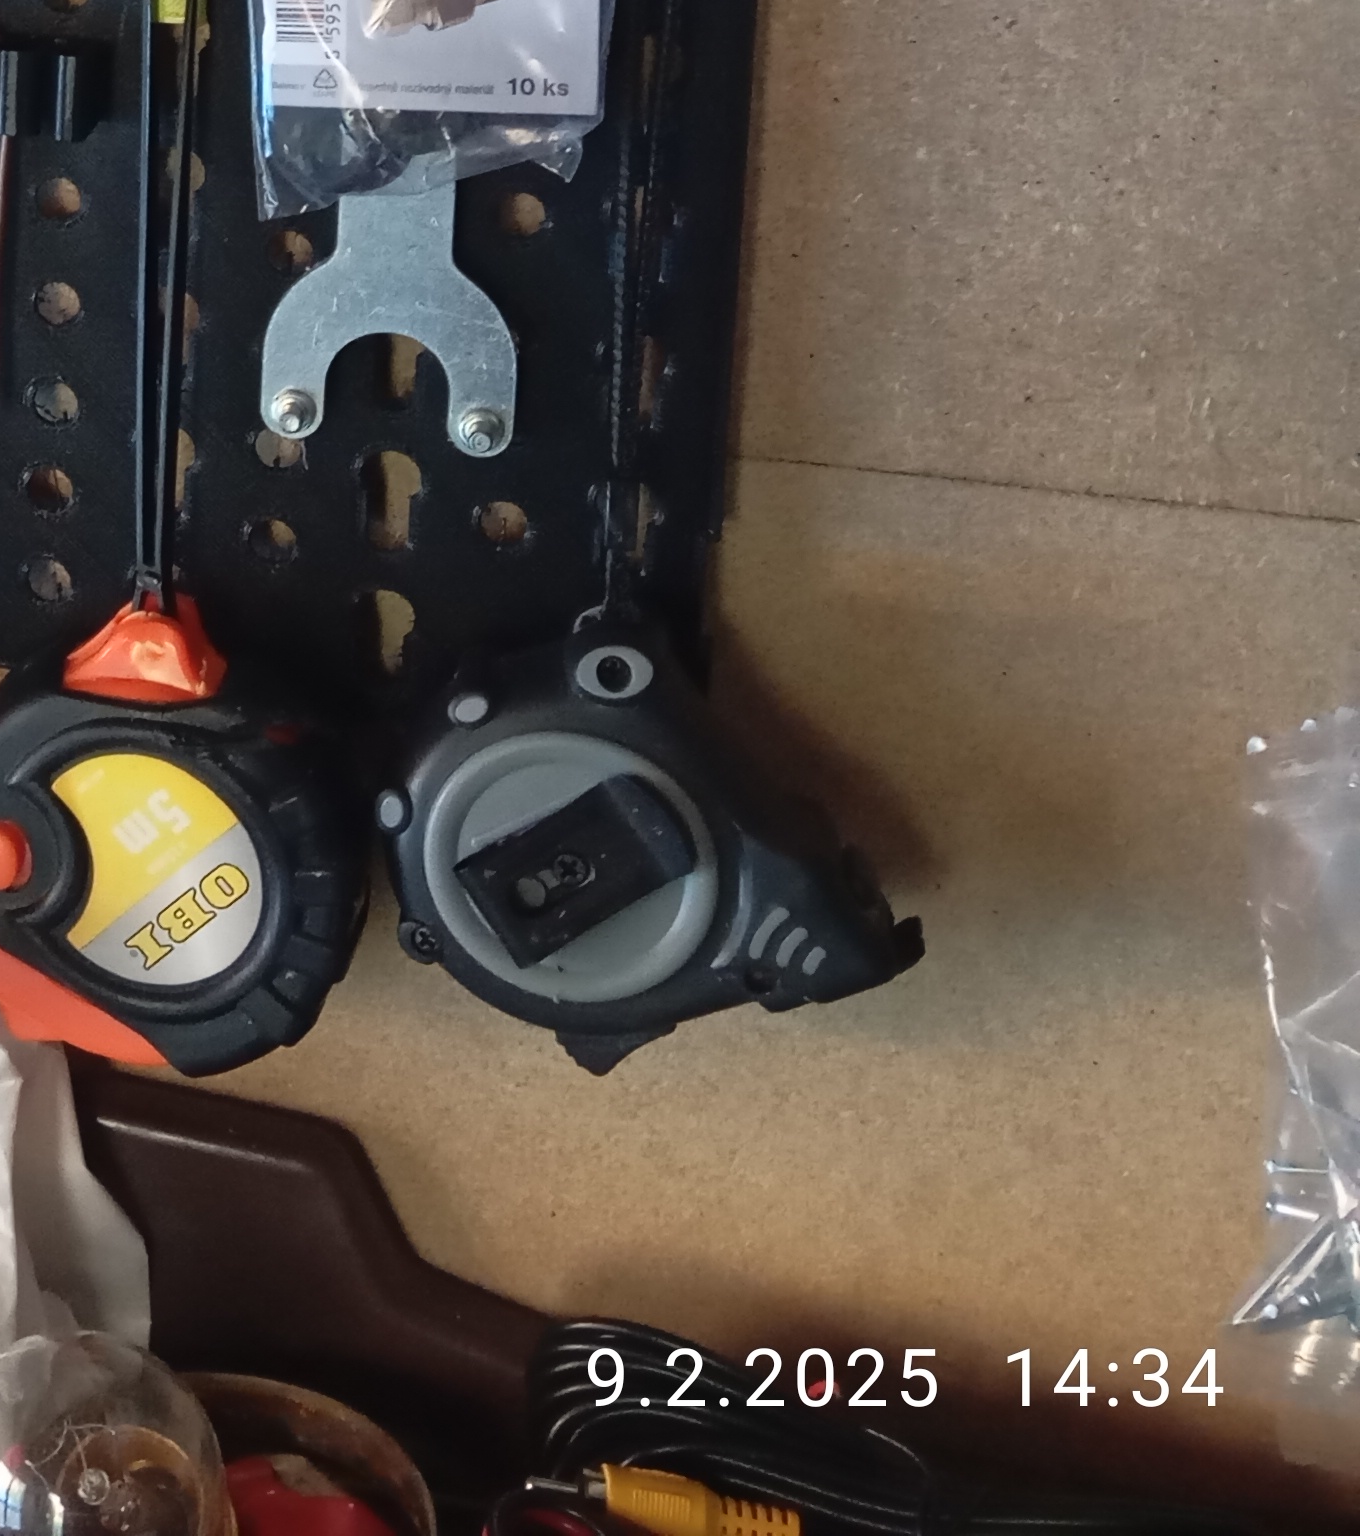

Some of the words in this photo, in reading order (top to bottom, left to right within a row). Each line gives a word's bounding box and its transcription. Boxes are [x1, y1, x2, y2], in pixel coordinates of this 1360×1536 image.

[506, 77, 535, 96] 10
[543, 78, 570, 96] ks
[123, 862, 250, 971] OBI
